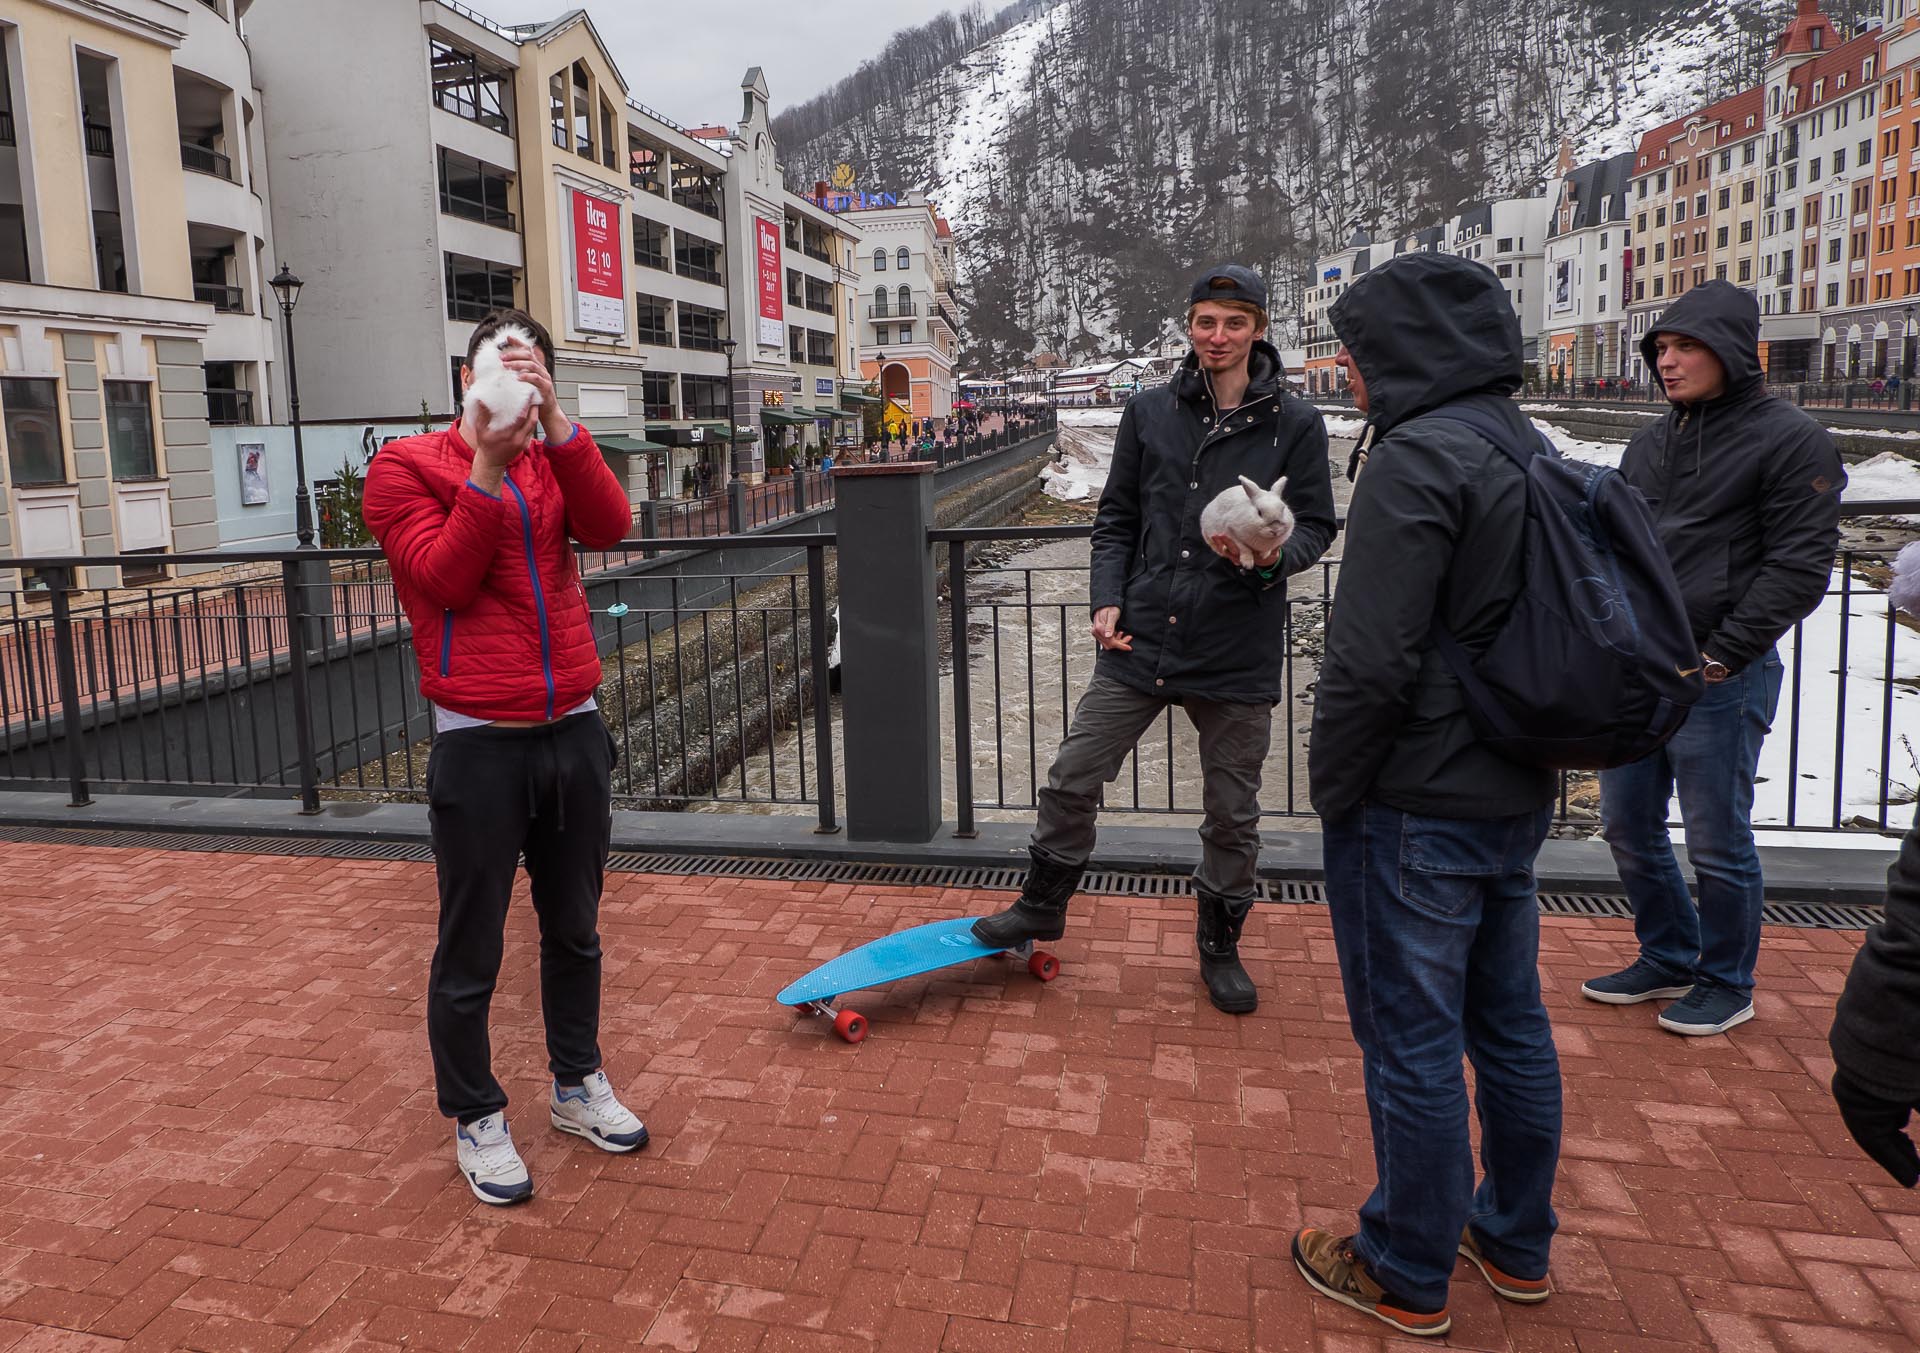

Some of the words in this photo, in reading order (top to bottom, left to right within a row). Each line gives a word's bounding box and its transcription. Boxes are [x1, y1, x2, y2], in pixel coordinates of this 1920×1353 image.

[860, 191, 897, 208] INN
[586, 200, 607, 229] ikra
[760, 224, 776, 253] ikra
[587, 248, 597, 265] 12
[602, 252, 611, 269] 10
